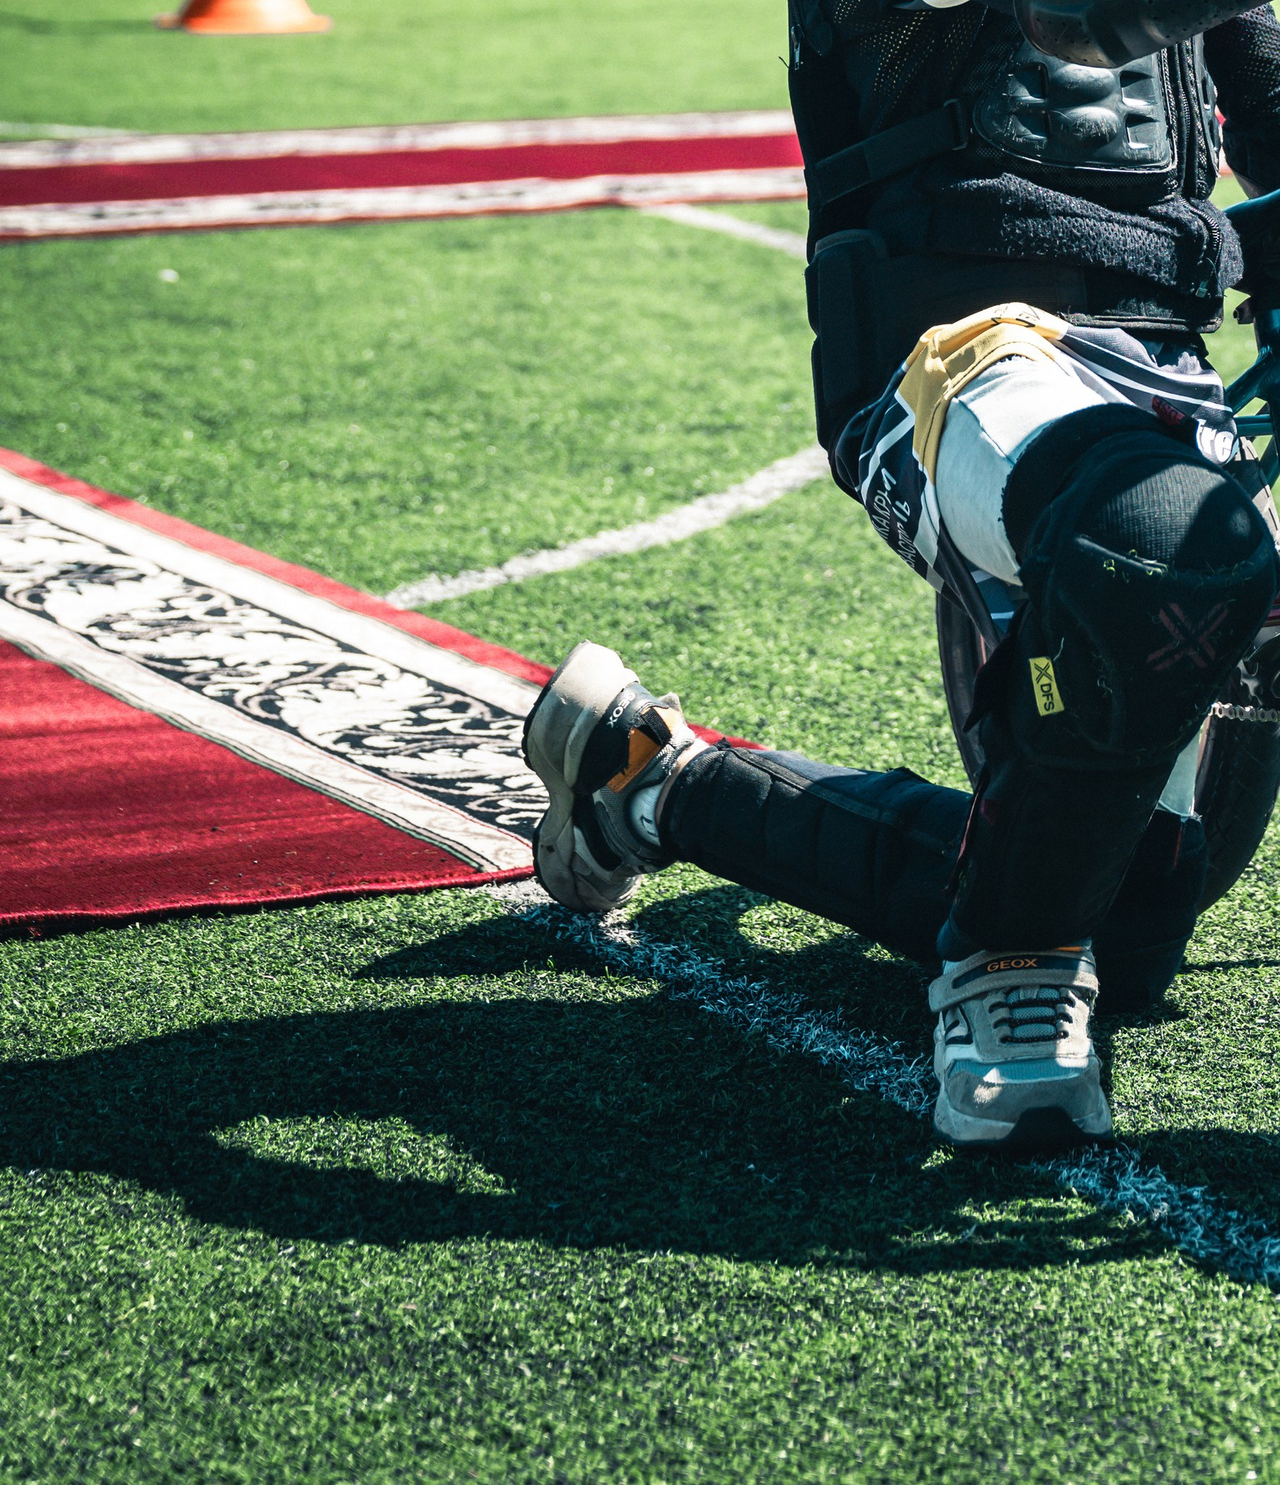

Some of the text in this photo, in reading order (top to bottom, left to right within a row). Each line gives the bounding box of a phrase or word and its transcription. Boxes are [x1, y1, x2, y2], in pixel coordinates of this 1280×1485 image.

[605, 691, 637, 729] GEOX
[1039, 683, 1056, 713] DFS
[986, 957, 1039, 973] GEOX
